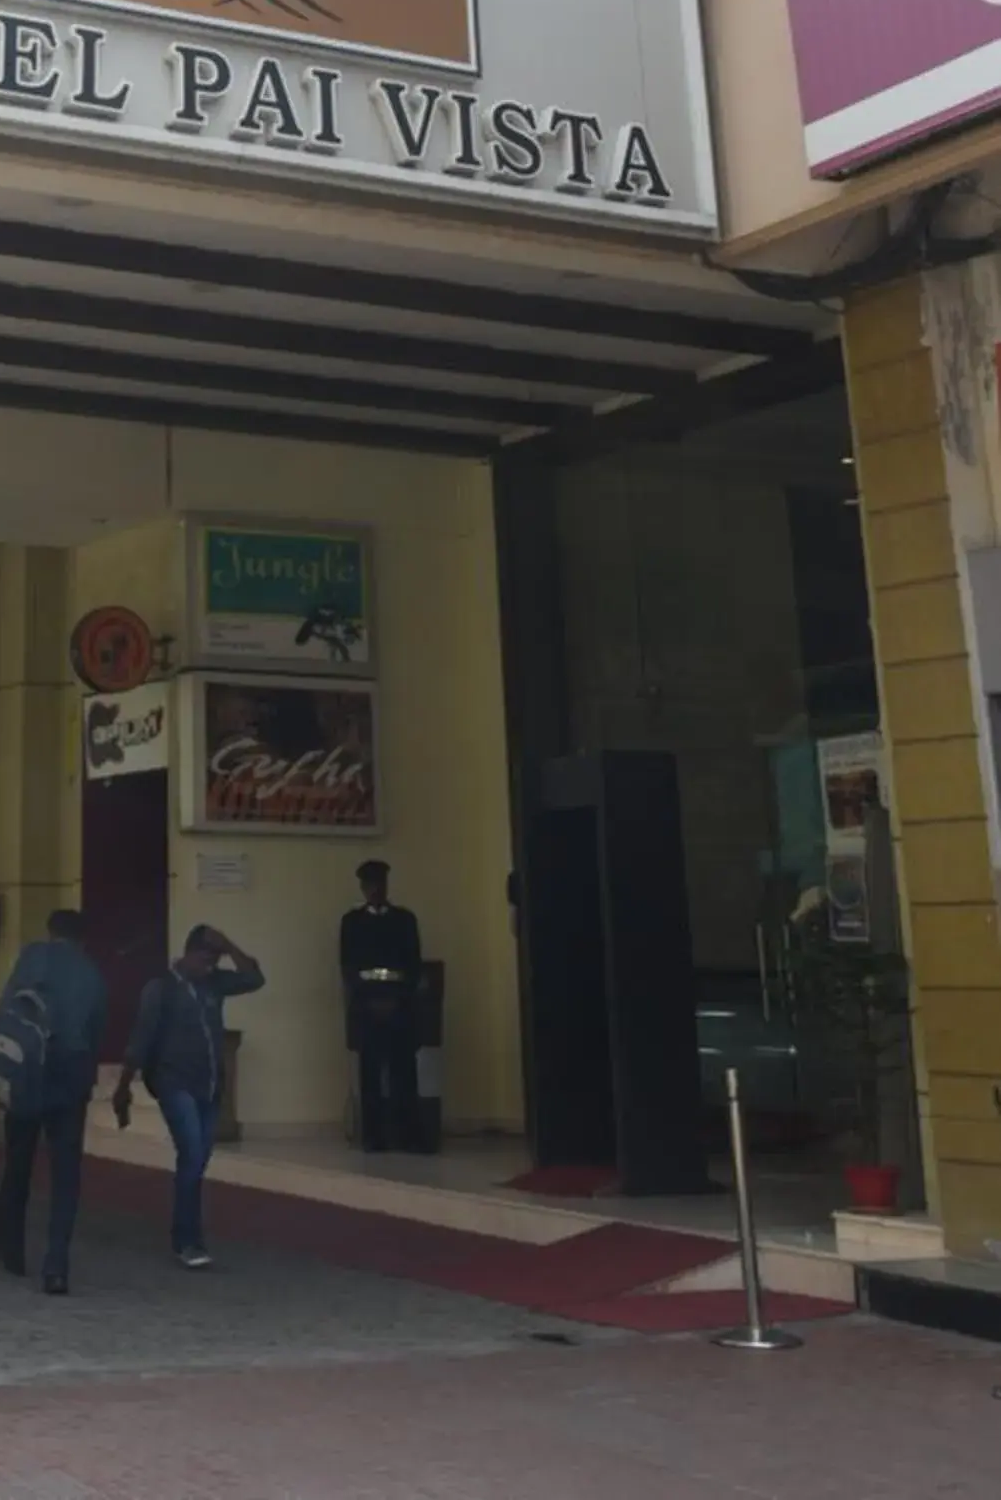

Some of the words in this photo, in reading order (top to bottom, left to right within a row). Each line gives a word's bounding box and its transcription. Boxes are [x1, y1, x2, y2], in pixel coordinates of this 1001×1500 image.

[173, 44, 342, 145] PAI
[378, 80, 672, 198] VISTA
[211, 536, 356, 596] Jungle
